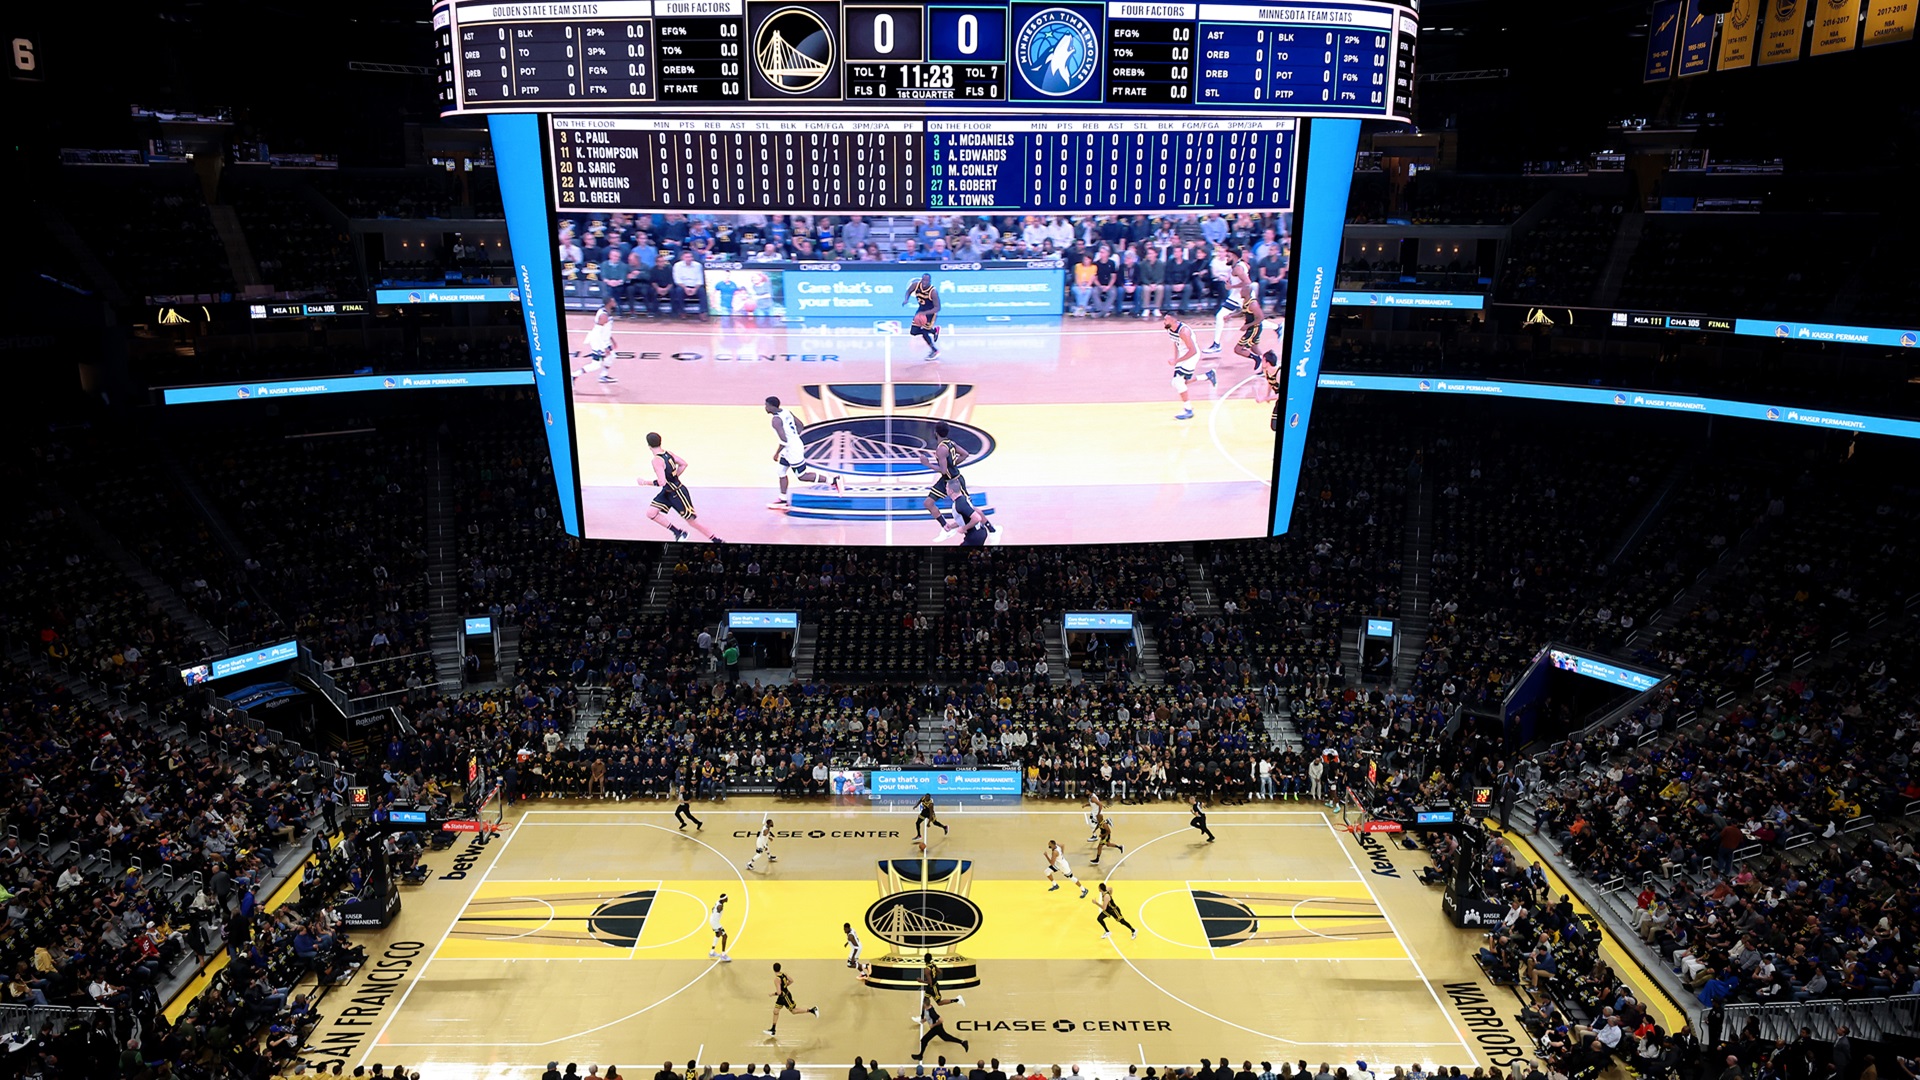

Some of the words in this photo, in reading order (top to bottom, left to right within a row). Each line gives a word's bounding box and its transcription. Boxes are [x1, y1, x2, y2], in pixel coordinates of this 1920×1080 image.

[492, 5, 520, 17] GOLDEN
[522, 5, 546, 16] STATE
[548, 4, 566, 15] TEAM
[568, 4, 598, 15] STATS
[667, 2, 688, 14] FOUR
[689, 2, 730, 13] FACTORS
[1121, 5, 1142, 16] FOUR
[1145, 5, 1185, 17] FACTORS
[1877, 4, 1907, 16] 2017-2018
[1258, 8, 1305, 21] MINNESOTA
[1307, 11, 1327, 22] TEAM
[1330, 11, 1353, 23] STATS
[1823, 16, 1849, 27] 2016-2017
[464, 32, 474, 41] AST
[518, 29, 533, 38] BLK
[873, 13, 894, 54] 0
[958, 13, 979, 55] 0
[1874, 25, 1904, 37] CHAMPIONS
[1020, 13, 1055, 63] MINNESOTA
[1060, 13, 1094, 81] TIMBERWOLVES
[1820, 37, 1846, 47] CHAMPIONS
[12, 37, 36, 71] 6
[465, 50, 480, 59] OREB
[519, 49, 529, 57] TO
[466, 69, 481, 78] DREB
[520, 67, 536, 76] POT
[854, 67, 874, 78] TOL
[879, 66, 886, 79] 7
[900, 65, 954, 88] 11:23
[965, 68, 986, 78] TOL
[991, 66, 997, 79] 7
[468, 88, 478, 97] STL
[521, 86, 539, 95] PITP
[854, 86, 873, 97] FLS
[879, 84, 886, 97] 0
[897, 90, 910, 99] 1st
[912, 90, 954, 100] QUARTER
[966, 86, 984, 97] FLS
[990, 85, 997, 98] 0
[560, 132, 567, 143] 3
[575, 132, 584, 144] C.
[586, 132, 609, 144] PAUL
[933, 134, 940, 145] 3
[948, 134, 957, 146] J.
[959, 134, 1014, 146] MCDANIELS
[560, 148, 569, 159] 11
[576, 147, 586, 159] K.
[588, 148, 638, 159] THOMPSON
[934, 150, 940, 160] 5
[948, 149, 958, 161] A.
[960, 149, 1007, 161] EDWARDS
[560, 162, 572, 173] 20
[577, 162, 587, 173] D.
[589, 162, 616, 174] SARIC
[931, 165, 943, 176] 10
[948, 164, 960, 176] M.
[962, 164, 998, 177] CONLEY
[561, 177, 574, 188] 22
[579, 177, 589, 188] A.
[591, 177, 630, 189] WIGGINS
[931, 180, 943, 190] 27
[948, 179, 958, 191] R.
[960, 179, 997, 191] GOBERT
[562, 191, 575, 202] 23
[580, 192, 589, 203] D.
[591, 192, 620, 203] GREEN
[930, 195, 943, 205] 32
[948, 194, 958, 206] K.
[960, 194, 994, 206] TOWNS
[798, 282, 831, 294] Care
[833, 281, 873, 293] that's
[874, 284, 893, 293] on
[798, 298, 831, 309] your
[833, 297, 873, 307] team.
[288, 306, 300, 314] 111
[1304, 312, 1316, 353] KAISER
[1311, 266, 1324, 308] PERMA
[1634, 316, 1649, 324] MIA
[1650, 316, 1662, 325] 111
[1670, 318, 1687, 326] CHA
[1688, 319, 1700, 328] 105
[1708, 321, 1730, 329] FINAL
[529, 310, 541, 351] KAISER
[1811, 331, 1834, 340] KAISER
[1835, 333, 1869, 342] PERMANE
[714, 353, 839, 362] CENTER
[288, 386, 327, 394] PERMANENTE.
[1466, 385, 1502, 393] PERMANENTE.
[1645, 399, 1665, 407] KAISER
[1666, 401, 1706, 410] PERMANENTE.
[1800, 415, 1820, 423] KAISER
[1821, 417, 1865, 428] PERMANENTE.
[356, 714, 385, 727] Rakuten
[334, 941, 425, 1025] FRANCISCO
[956, 1021, 1047, 1031] CHASE
[1083, 1021, 1172, 1032] CENTER
[1443, 982, 1531, 1067] WARRIORS
[305, 1032, 365, 1069] SAN
